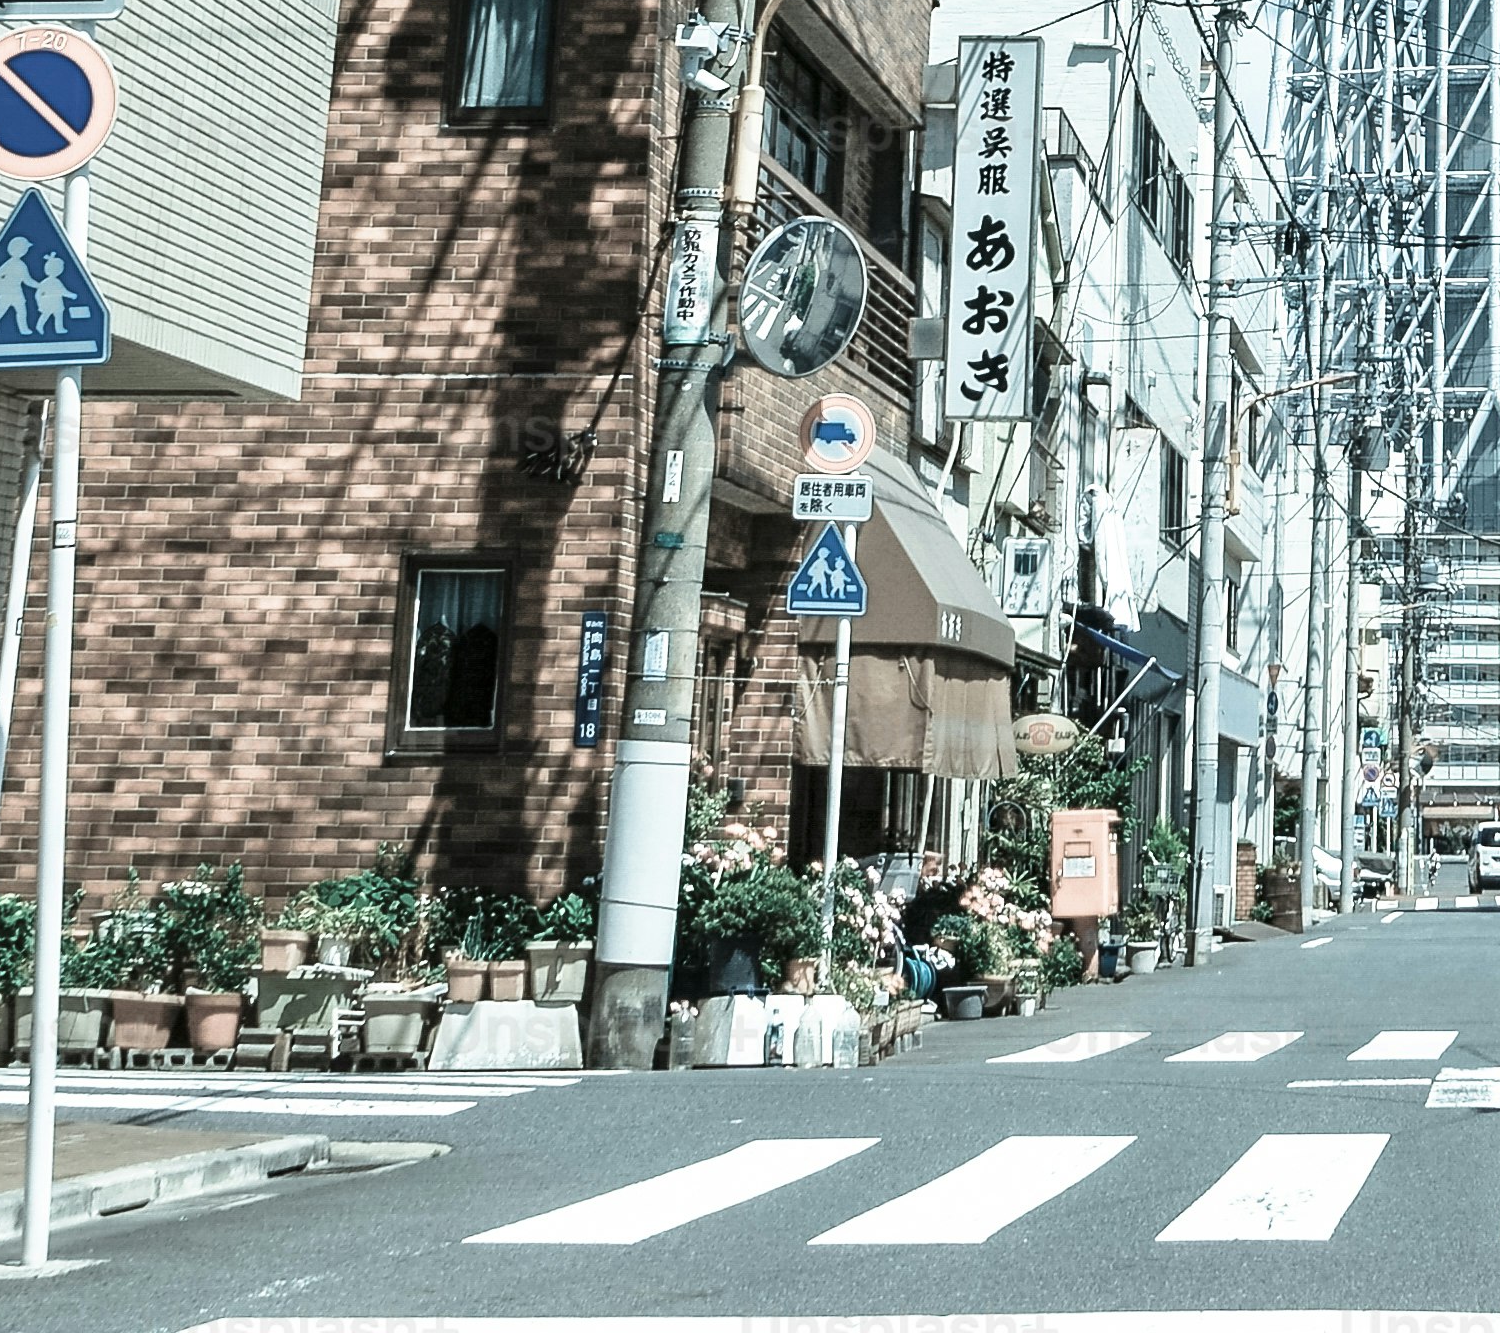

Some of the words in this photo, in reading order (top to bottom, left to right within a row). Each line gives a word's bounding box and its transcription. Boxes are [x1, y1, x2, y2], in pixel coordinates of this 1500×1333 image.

[977, 50, 1016, 196] 特選呉服
[960, 214, 1015, 402] あおき
[799, 481, 867, 498] 居住者用車両
[799, 497, 833, 513] を除く
[579, 722, 596, 739] 18
